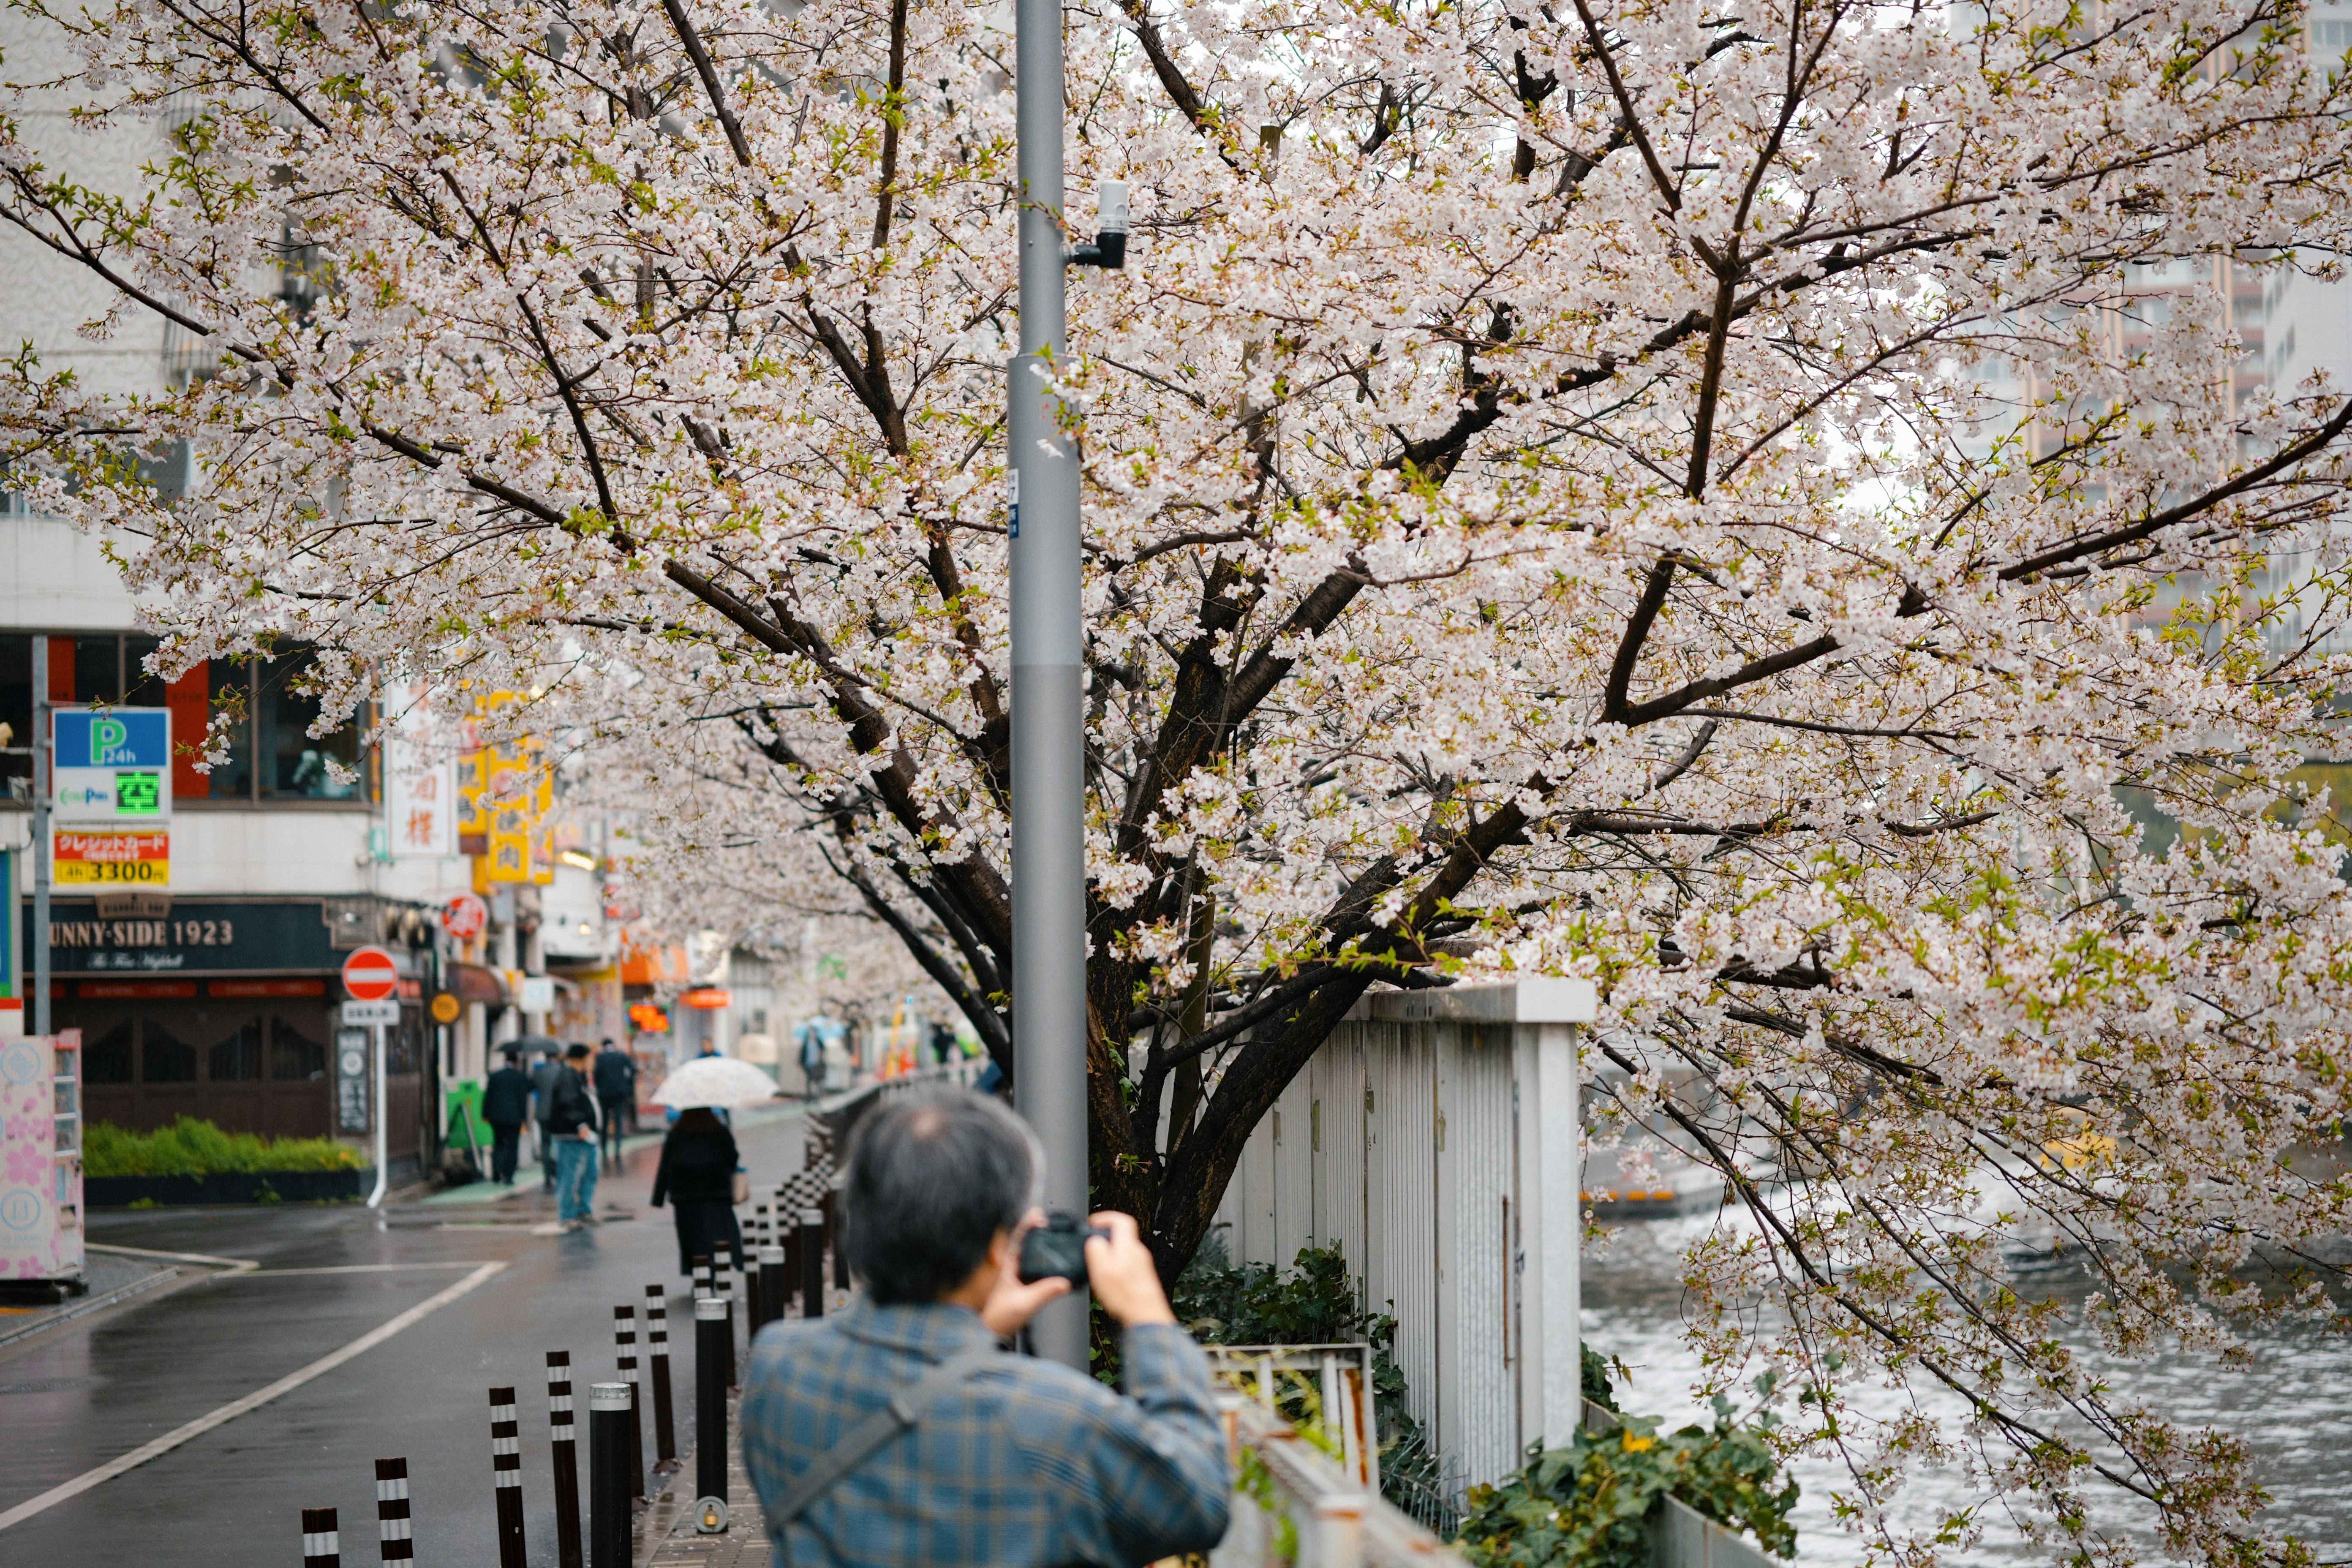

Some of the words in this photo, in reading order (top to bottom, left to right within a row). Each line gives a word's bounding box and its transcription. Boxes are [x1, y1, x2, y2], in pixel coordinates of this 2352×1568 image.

[90, 718, 127, 765] P
[106, 749, 136, 763] 24h
[117, 771, 159, 815] 空
[60, 834, 165, 852] クレジットカード
[174, 920, 233, 946] 1923
